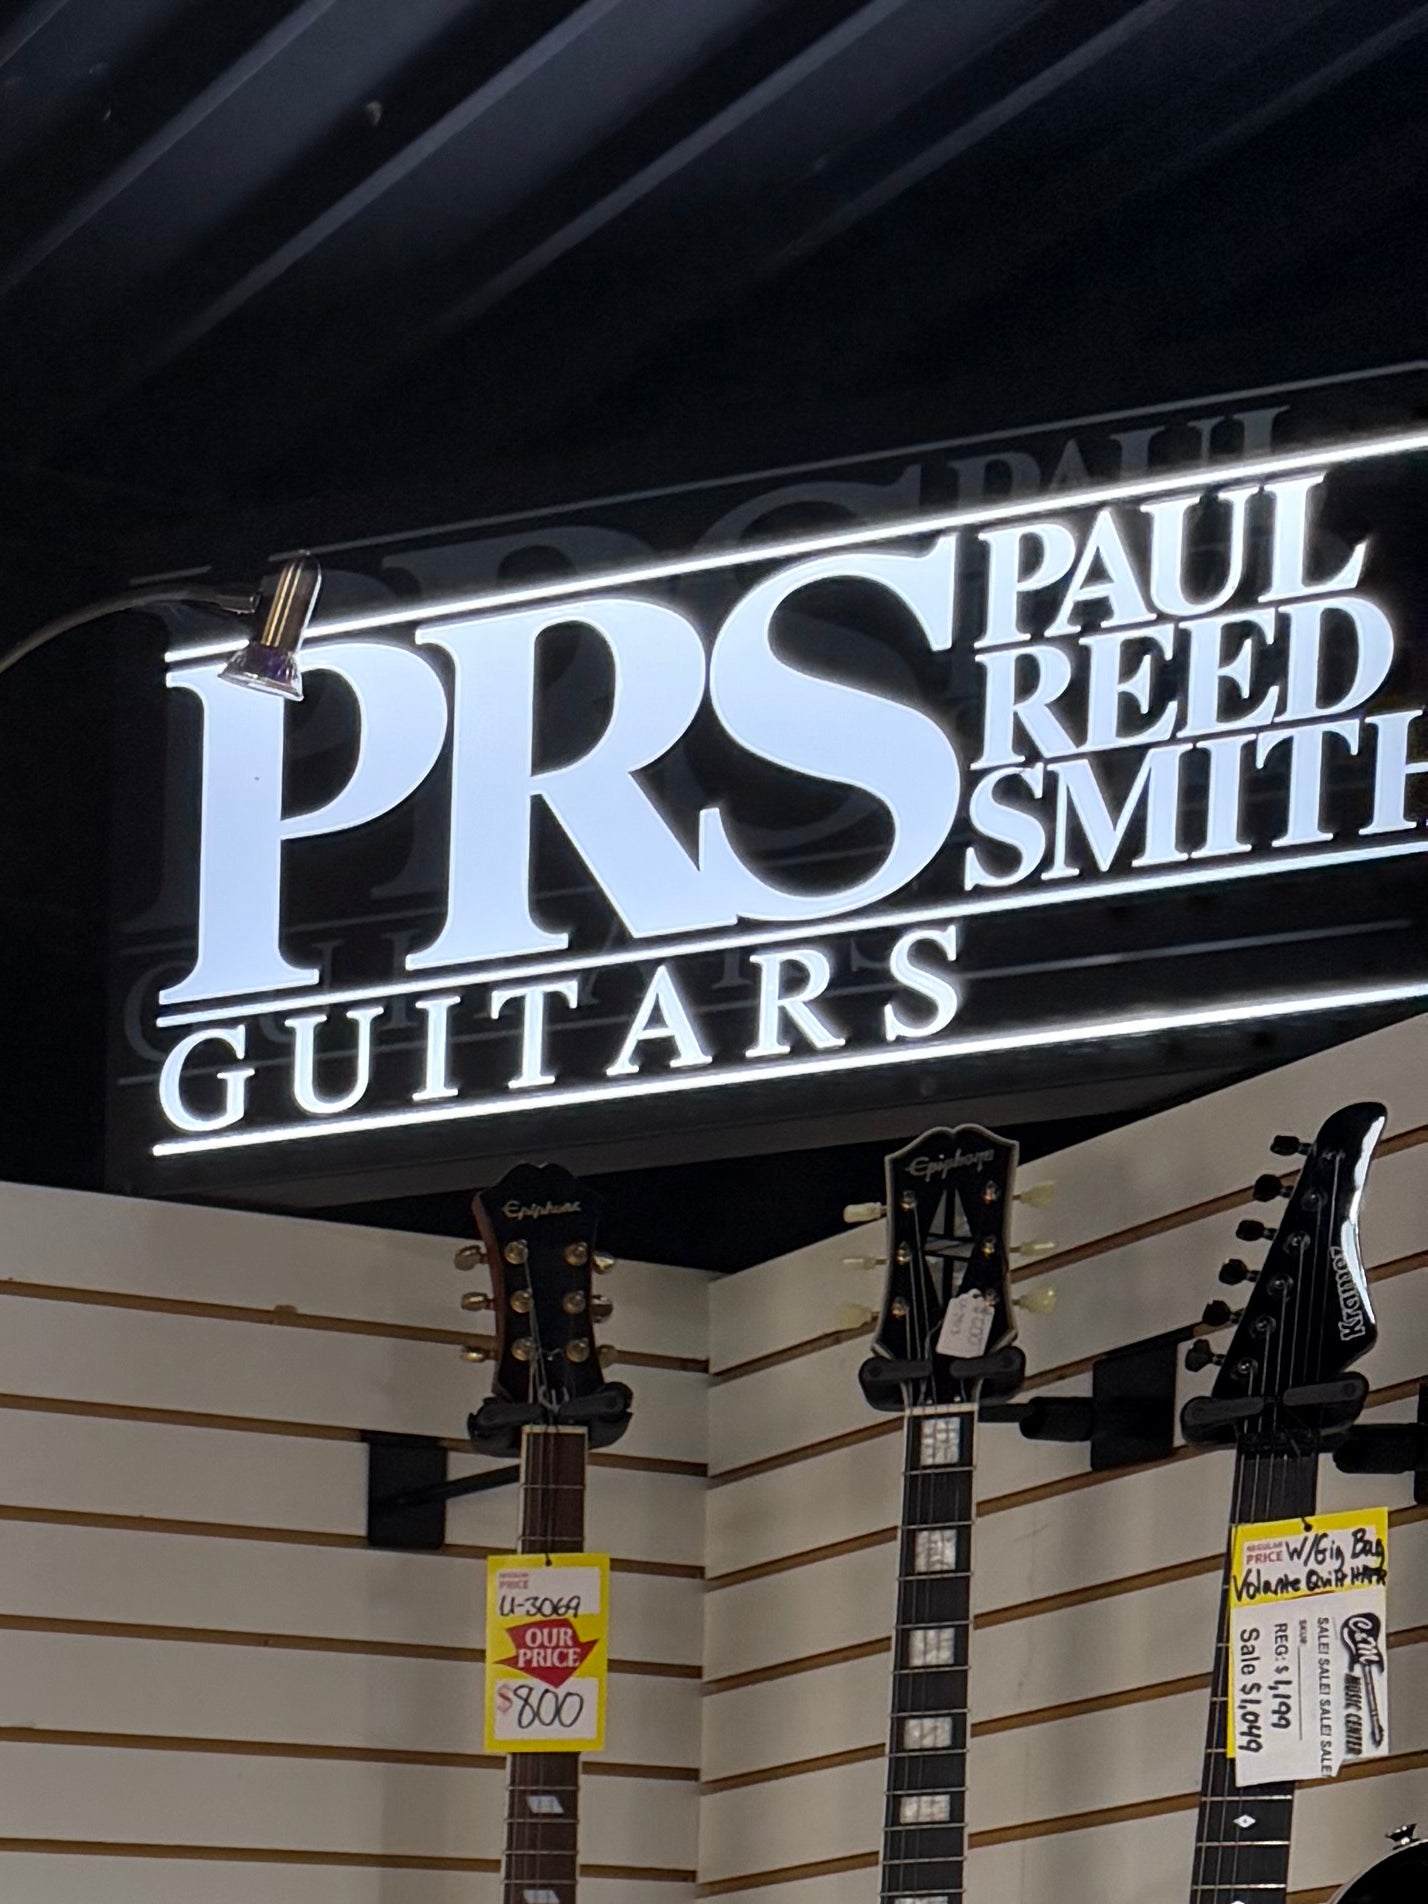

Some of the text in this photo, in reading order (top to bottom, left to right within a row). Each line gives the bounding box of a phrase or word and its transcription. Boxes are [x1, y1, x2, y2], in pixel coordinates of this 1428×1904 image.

[974, 472, 1368, 649] PAUL
[970, 596, 1395, 769] REED
[158, 534, 962, 1005] PRS
[158, 925, 960, 1132] GUITARS
[906, 1146, 995, 1181] Epiphone
[502, 1200, 581, 1221] Epiphone
[1330, 1246, 1365, 1341] Kramer
[1246, 1551, 1283, 1565] PRICE
[525, 1628, 573, 1647] OUR
[1240, 1628, 1260, 1675] Sale
[1274, 1623, 1288, 1661] REG:
[1317, 1617, 1330, 1654] SALE!
[518, 1649, 581, 1667] PRICE
[1319, 1658, 1331, 1695] SALE!
[497, 1684, 584, 1728] $800
[1320, 1699, 1331, 1736] SALE!
[1344, 1674, 1363, 1756] MUSIC CENTER
